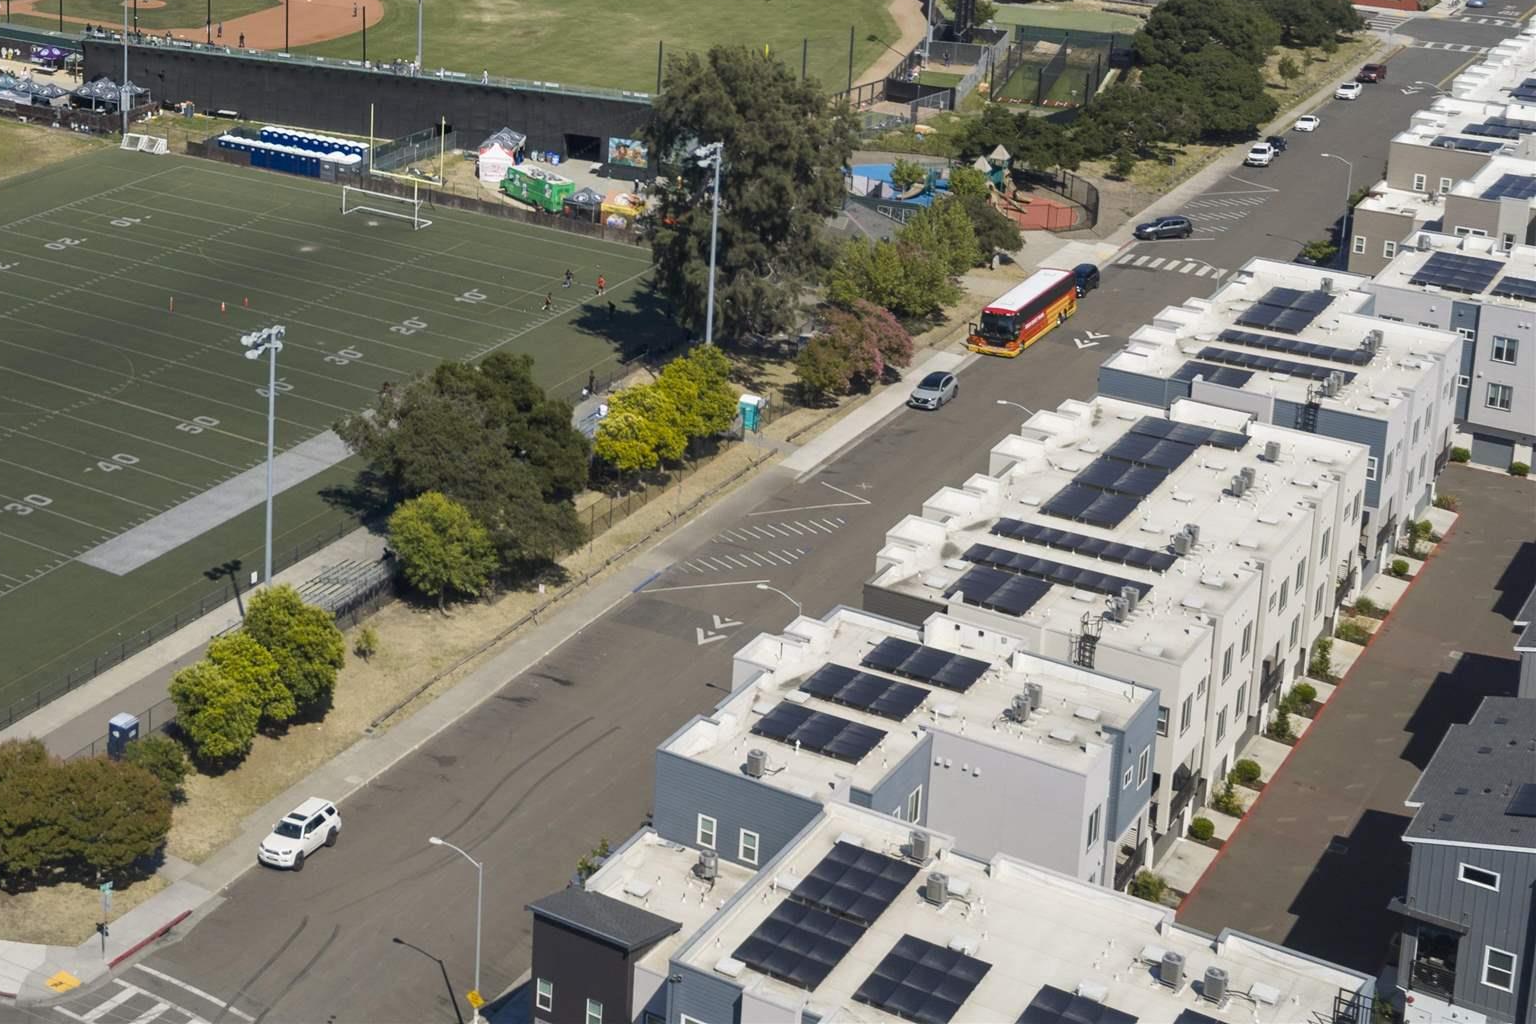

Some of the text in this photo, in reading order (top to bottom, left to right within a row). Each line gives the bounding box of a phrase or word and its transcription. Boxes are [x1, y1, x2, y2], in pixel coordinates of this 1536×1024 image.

[110, 216, 141, 227] 10
[44, 237, 81, 250] 20
[454, 291, 487, 304] 10
[389, 319, 428, 335] 20
[323, 349, 363, 365] 30
[175, 415, 220, 434] 50
[97, 453, 140, 472] 40
[4, 494, 53, 515] 30
